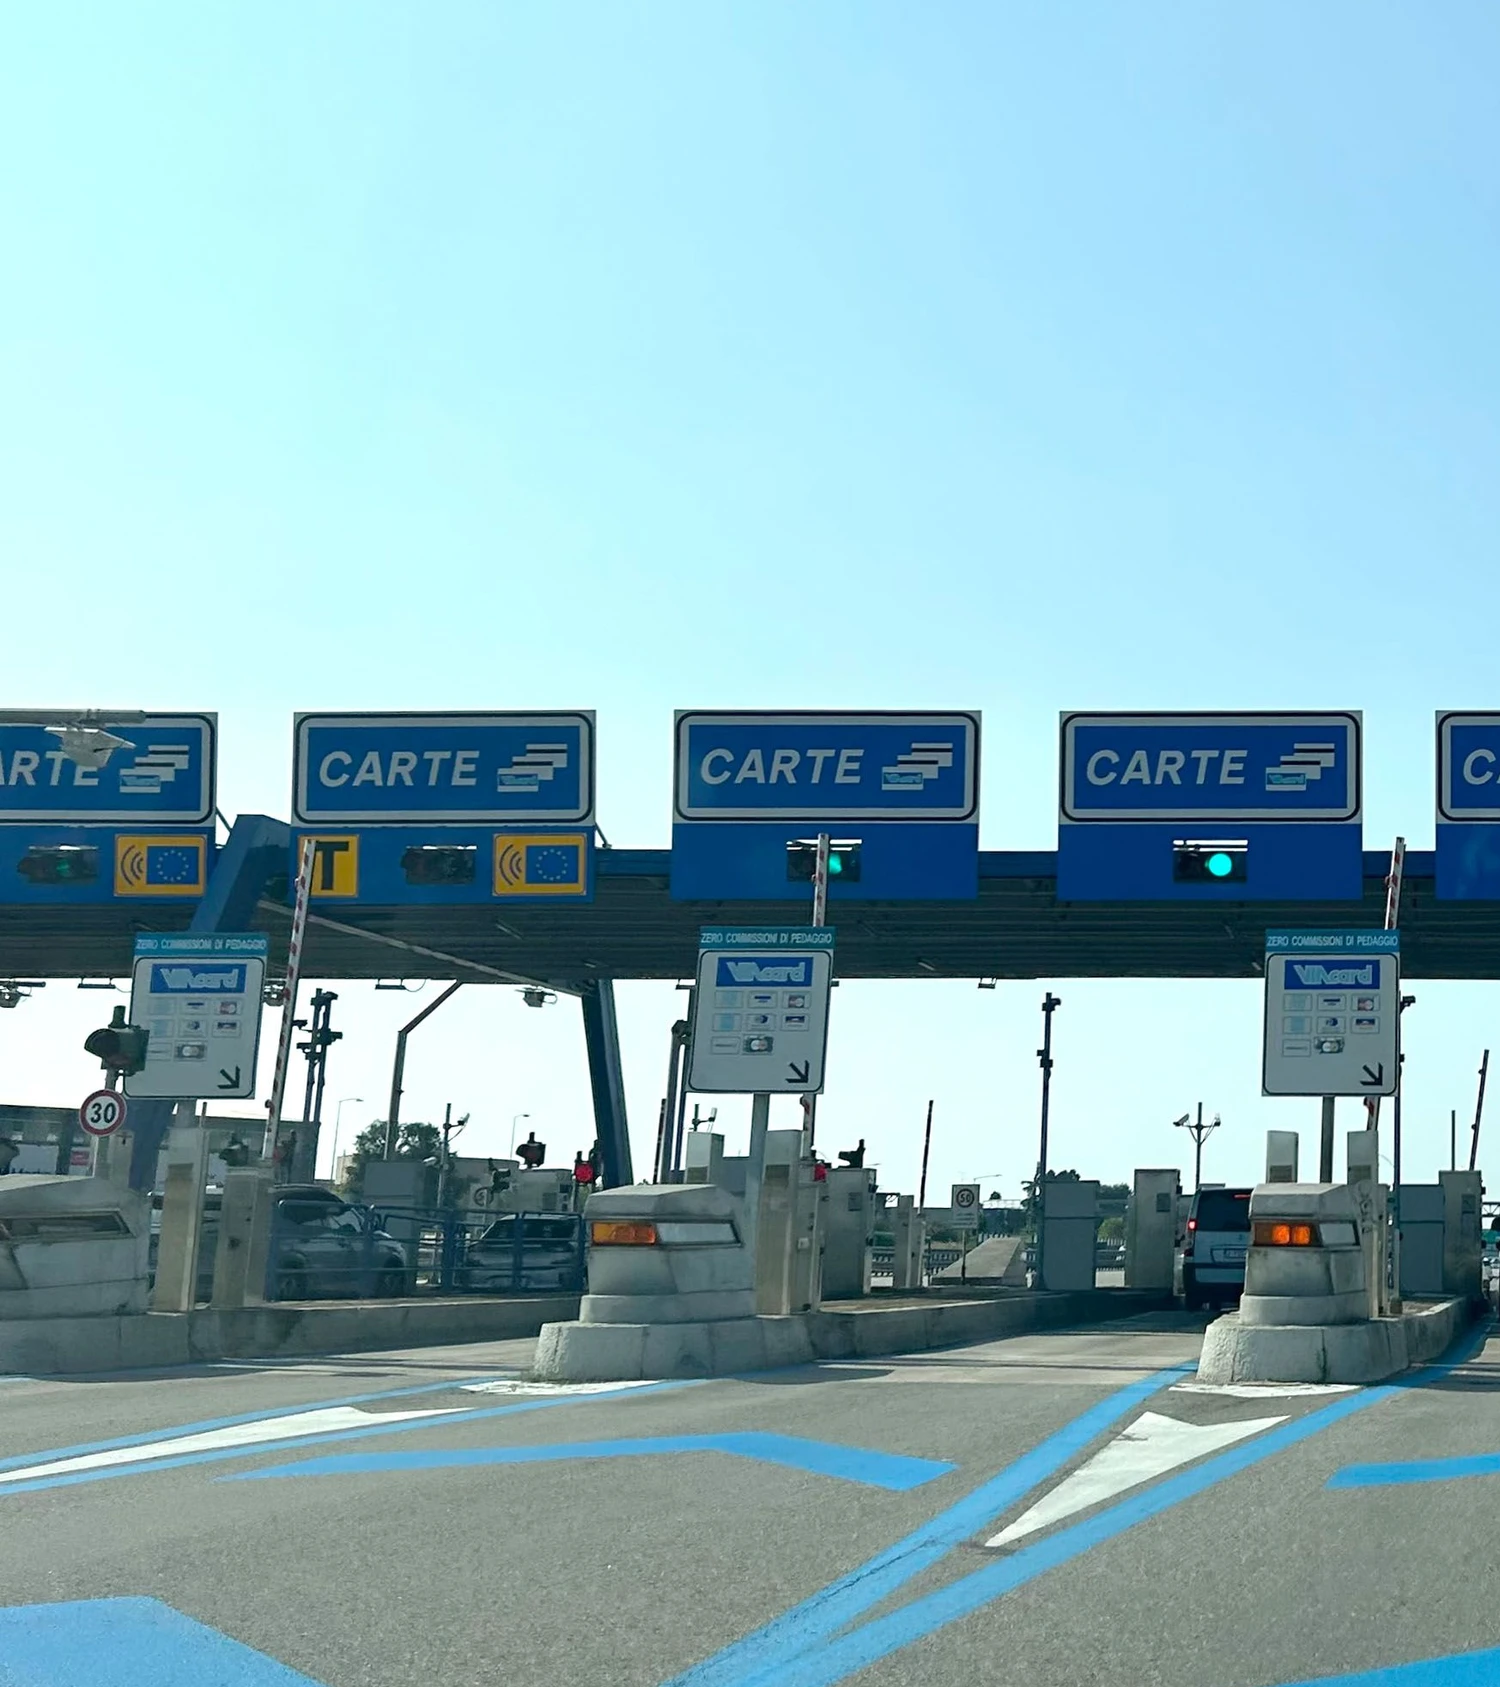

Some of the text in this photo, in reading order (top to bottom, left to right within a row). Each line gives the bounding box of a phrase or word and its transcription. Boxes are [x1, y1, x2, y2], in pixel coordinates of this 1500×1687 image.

[0, 751, 99, 786] RTE
[319, 750, 480, 787] CARTE
[700, 748, 865, 785] CARTE
[1086, 749, 1249, 786] CARTE
[316, 840, 349, 890] T
[701, 932, 723, 944] ZERO
[780, 932, 789, 943] DI
[791, 932, 832, 944] PEDAGGIO
[1267, 936, 1398, 947] ZERO COMMISSIONI DI PEDAGGIO
[90, 1102, 116, 1123] 30
[960, 1193, 971, 1203] 50
